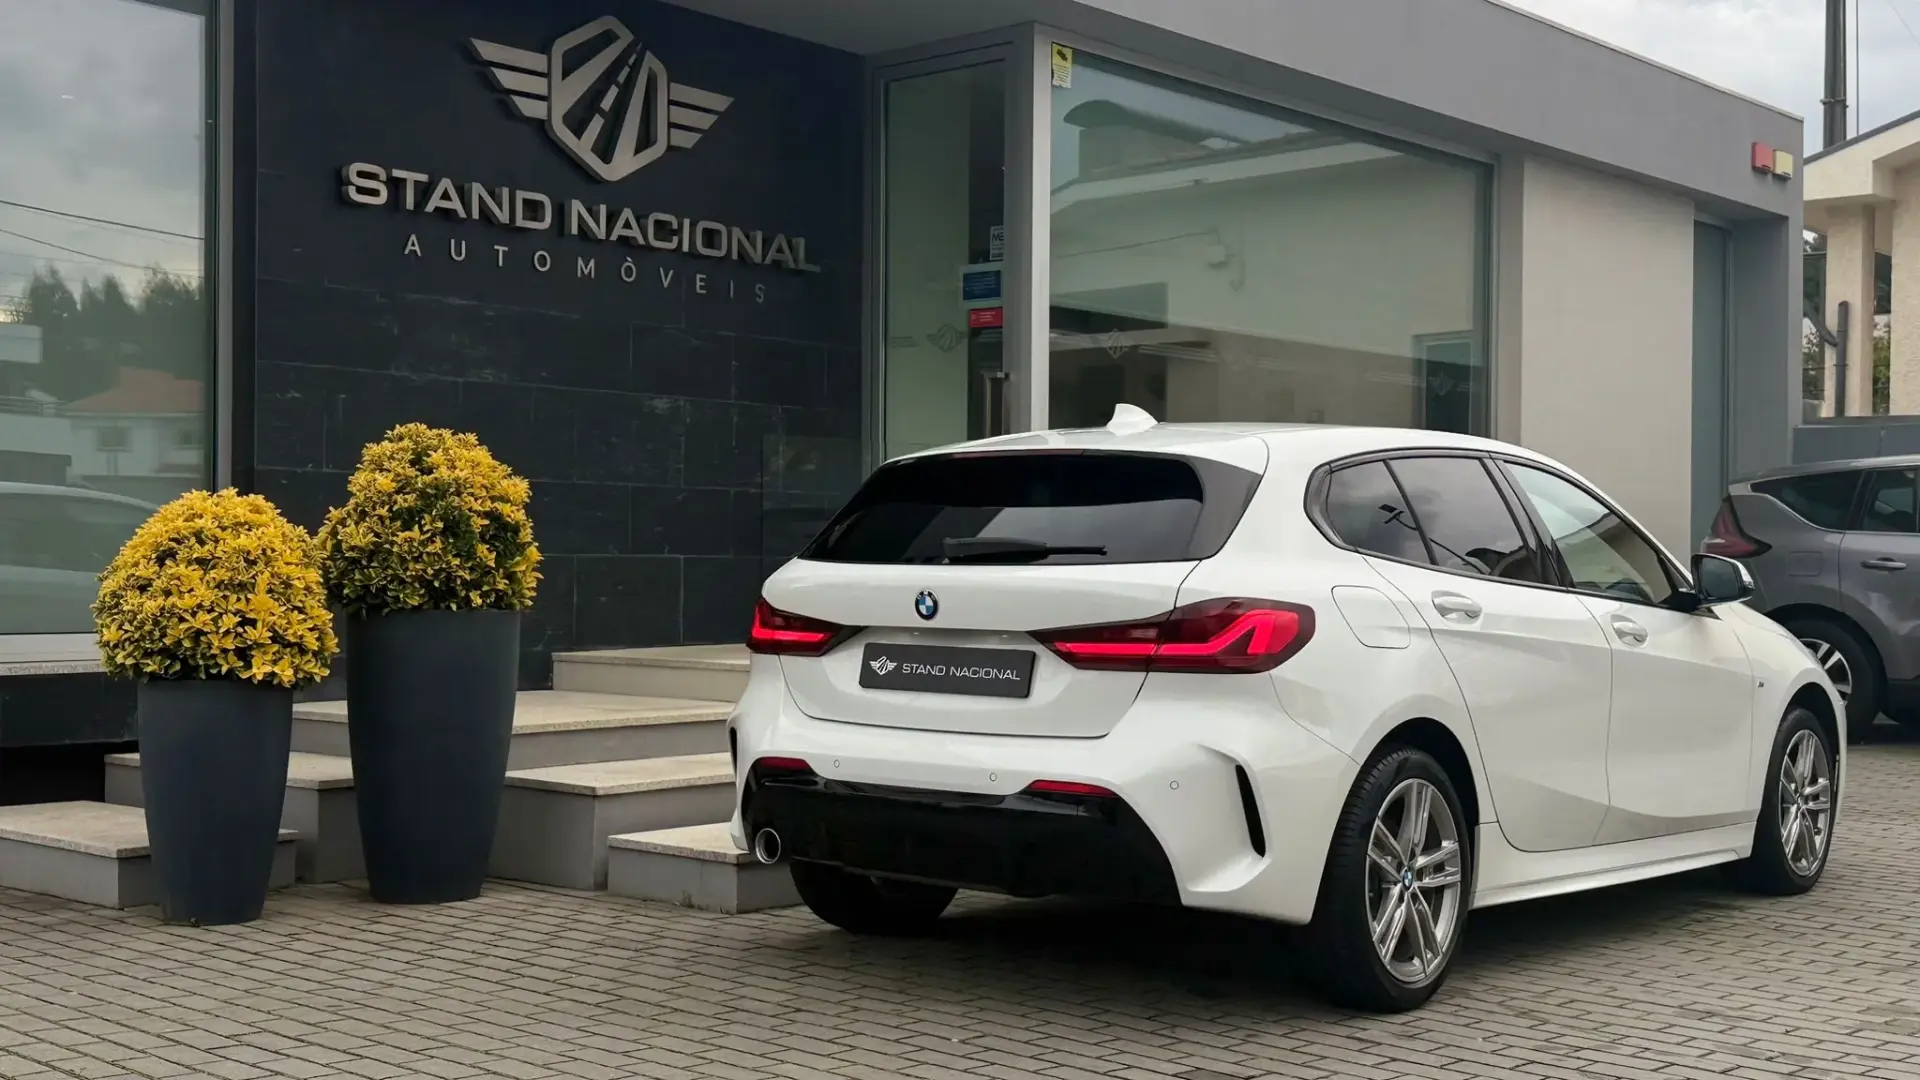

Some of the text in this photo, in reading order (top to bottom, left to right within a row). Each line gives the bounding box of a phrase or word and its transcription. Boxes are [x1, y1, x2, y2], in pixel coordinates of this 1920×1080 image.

[345, 162, 821, 273] STAND NACIONAL
[902, 663, 1021, 681] STAND NACIONAL
